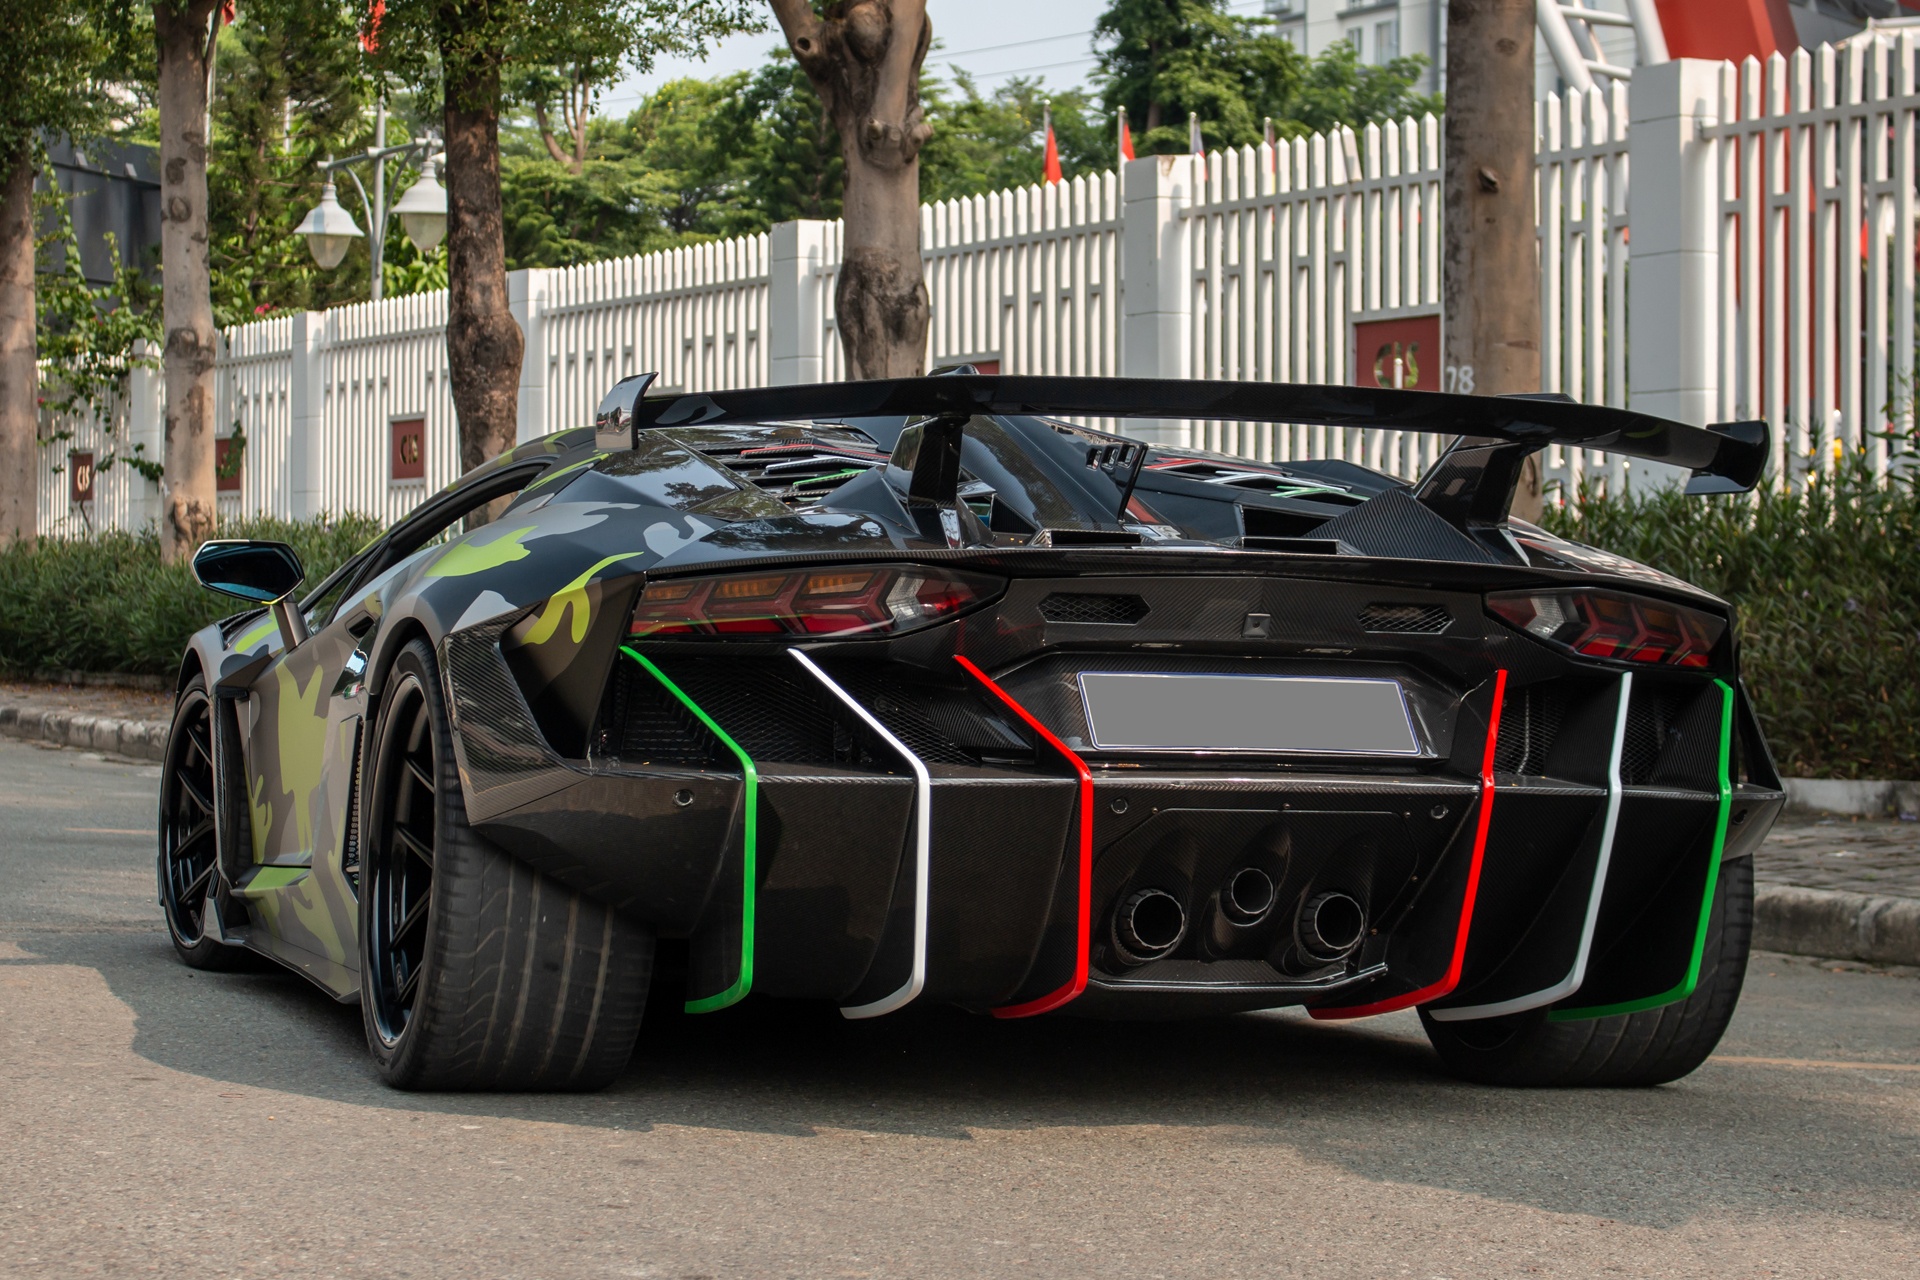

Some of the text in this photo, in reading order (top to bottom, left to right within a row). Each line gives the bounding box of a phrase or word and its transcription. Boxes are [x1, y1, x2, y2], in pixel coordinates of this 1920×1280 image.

[1373, 341, 1419, 389] CIS
[1446, 365, 1475, 395] 78
[400, 434, 418, 465] CIS
